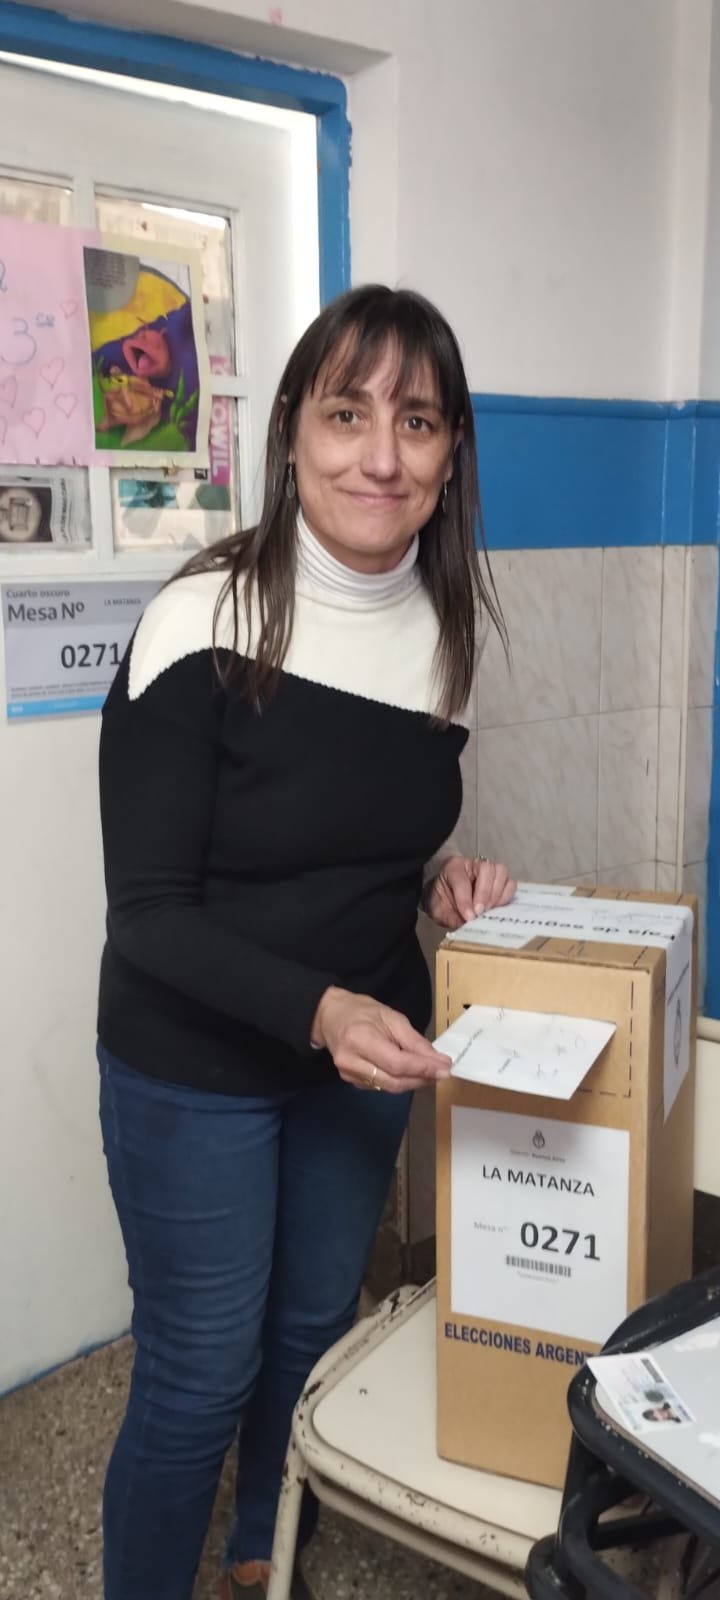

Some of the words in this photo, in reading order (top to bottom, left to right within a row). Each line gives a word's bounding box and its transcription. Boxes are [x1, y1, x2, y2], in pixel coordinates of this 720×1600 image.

[6, 588, 38, 599] Cuarto
[40, 589, 70, 597] oscuro
[7, 603, 58, 622] Mesa
[60, 642, 121, 669] 0271
[592, 925, 620, 934] de
[482, 1164, 502, 1181] LA
[507, 1168, 595, 1197] MATANZA
[520, 1221, 601, 1262] 0271
[444, 1322, 531, 1355] ELECCIONES
